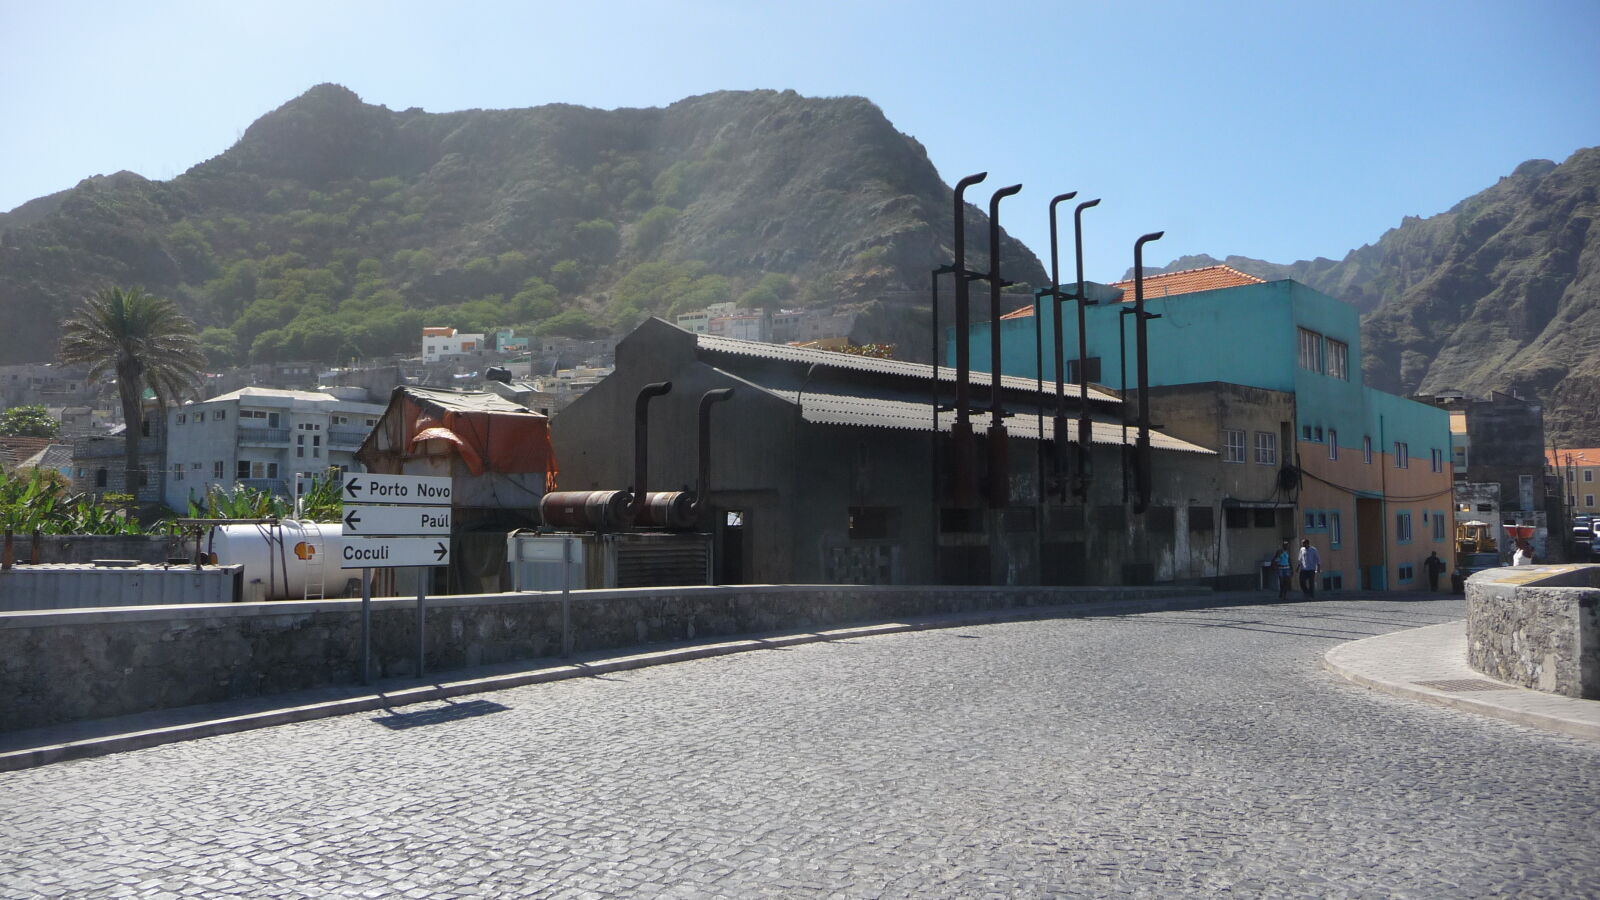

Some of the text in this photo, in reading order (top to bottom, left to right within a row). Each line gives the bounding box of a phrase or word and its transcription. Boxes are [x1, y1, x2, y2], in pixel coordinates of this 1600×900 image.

[370, 481, 450, 498] Porto Novo
[421, 513, 449, 528] Paúl
[343, 545, 389, 560] Coculi
